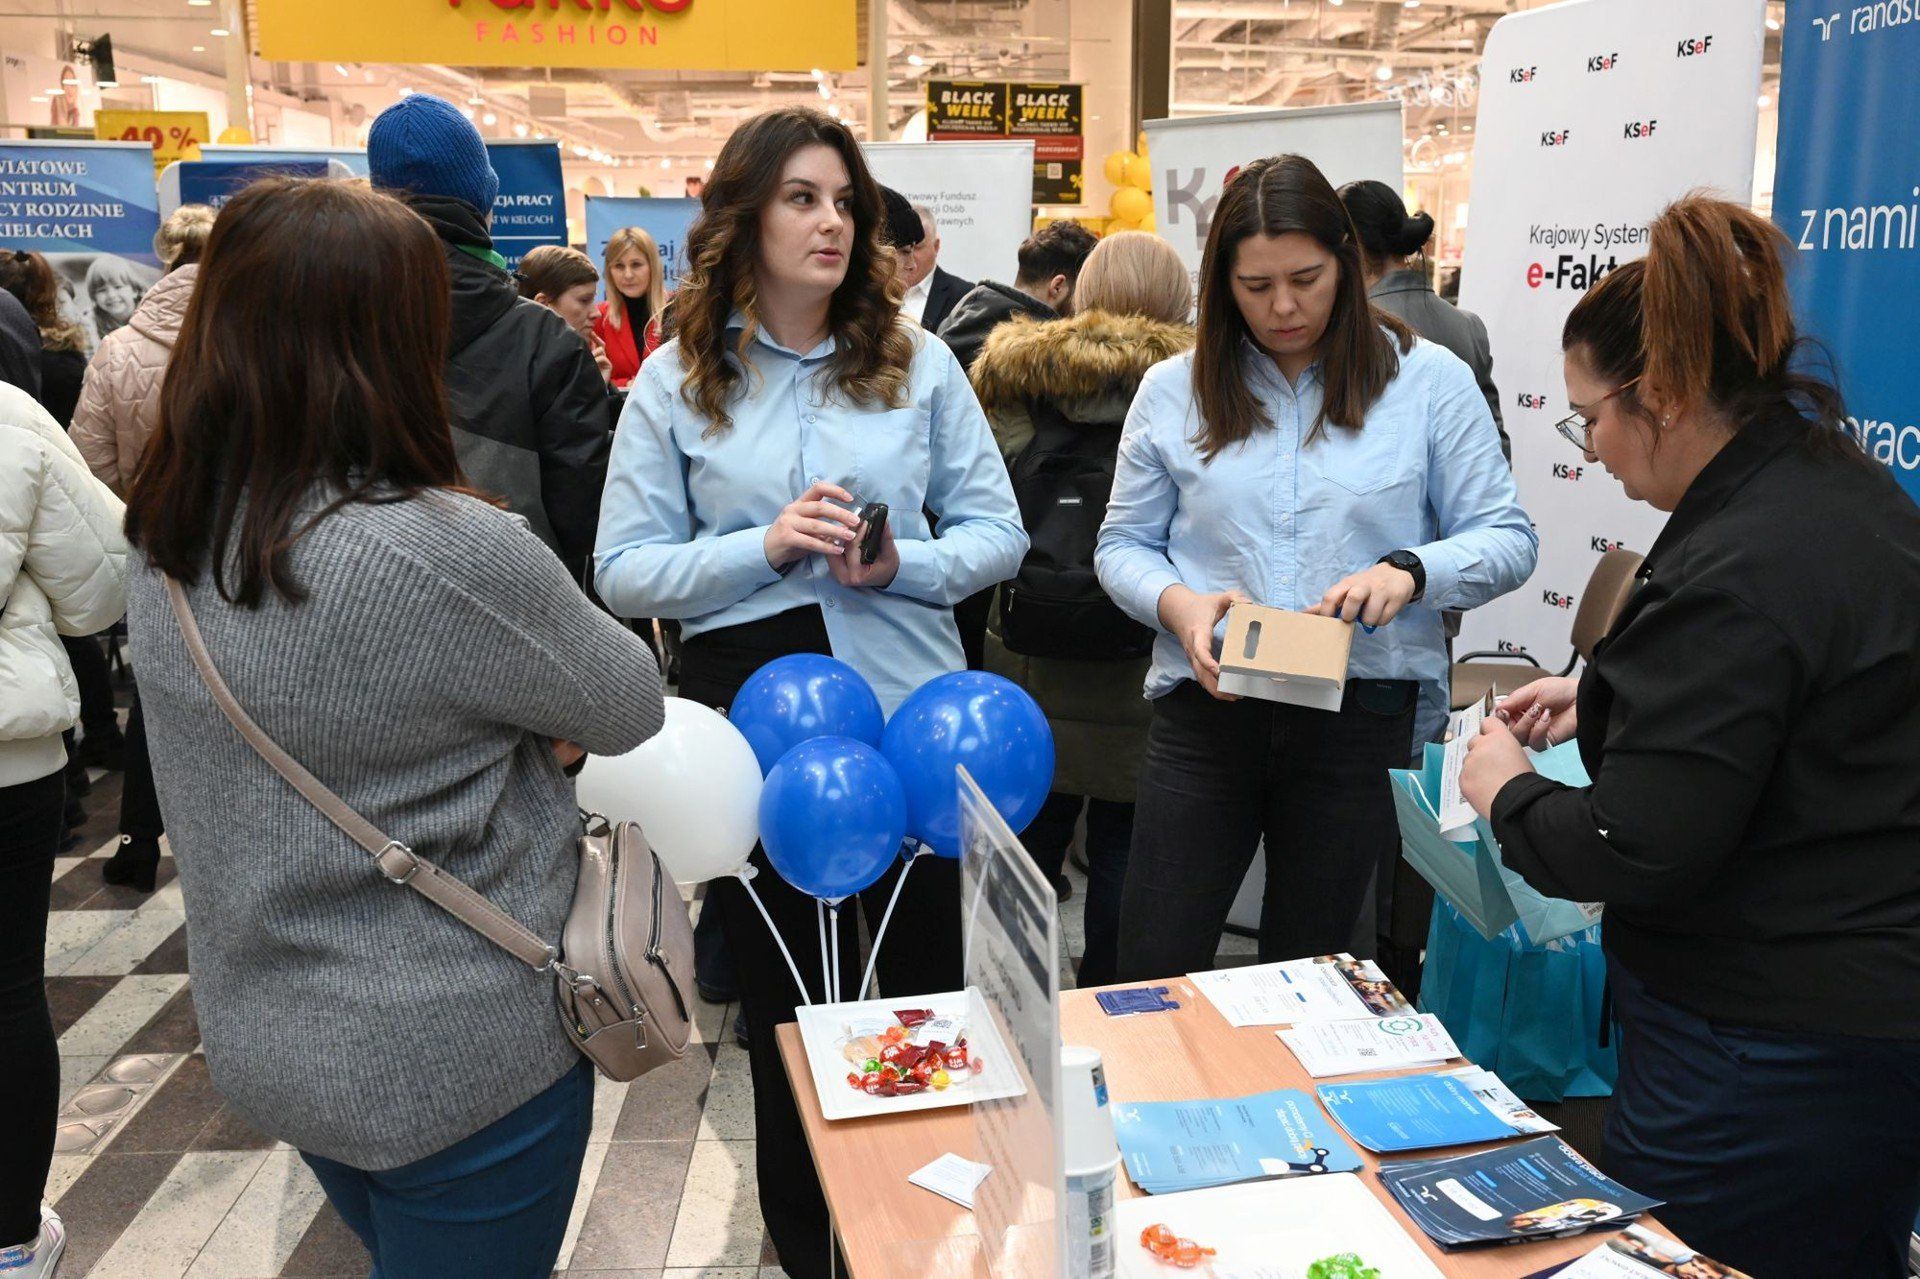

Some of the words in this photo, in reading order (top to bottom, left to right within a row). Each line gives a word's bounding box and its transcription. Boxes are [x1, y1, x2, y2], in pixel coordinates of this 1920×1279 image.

[476, 22, 657, 45] FASHION
[1677, 36, 1713, 57] KSeF
[1588, 53, 1618, 73] KSeF
[1510, 67, 1537, 83] KSeF
[941, 91, 995, 104] BLACK
[1016, 94, 1070, 107] BLACK
[947, 104, 991, 117] WEEK
[1022, 106, 1068, 119] WEEK
[1624, 120, 1657, 139] KSeF
[1541, 130, 1569, 147] KSeF
[0, 181, 77, 196] NTRUM
[940, 191, 977, 201] Fundusz
[516, 194, 554, 206] PRACY
[25, 203, 125, 217] RODZINIE
[1798, 210, 1817, 250] z
[1823, 187, 1920, 250] nami
[1529, 224, 1590, 250] Krajowy
[1517, 393, 1546, 410] KSeF
[1552, 462, 1583, 481] KSeF
[1543, 589, 1574, 609] KSeF
